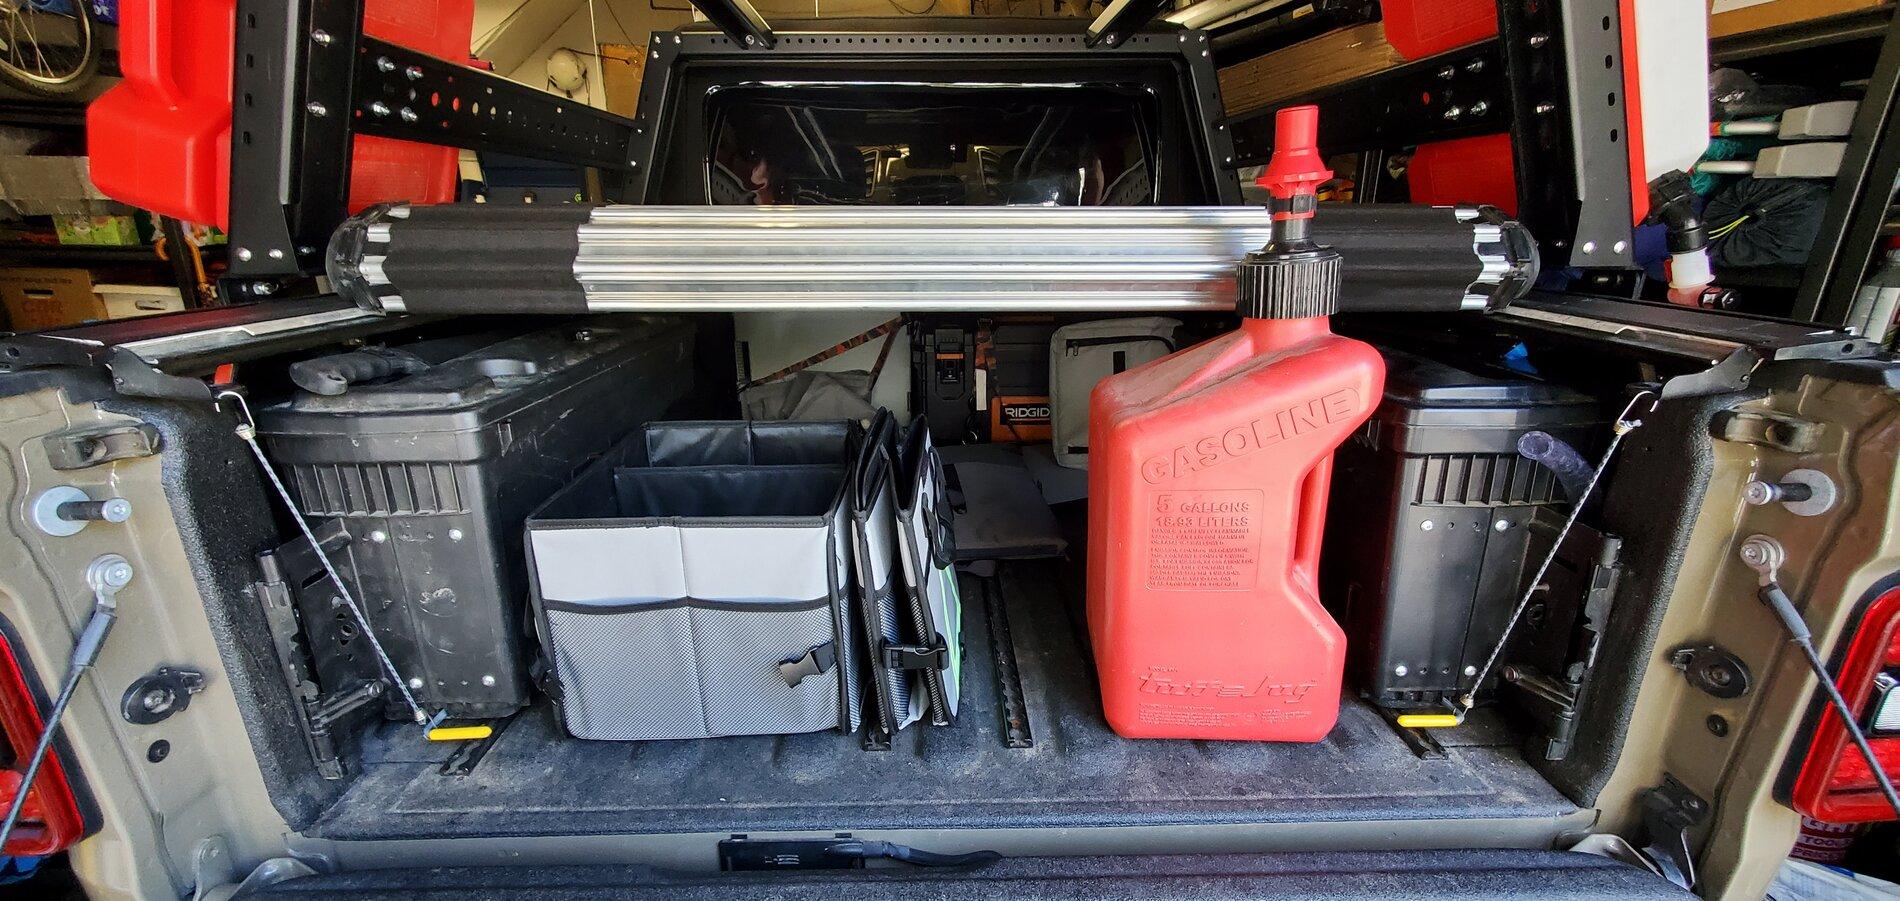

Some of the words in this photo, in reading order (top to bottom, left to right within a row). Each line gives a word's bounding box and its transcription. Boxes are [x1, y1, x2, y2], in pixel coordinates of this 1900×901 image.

[1004, 407, 1050, 418] RIDGID
[1140, 387, 1354, 484] GASOLINE
[1156, 494, 1173, 514] 5
[1180, 502, 1250, 514] GALLONS
[1198, 516, 1249, 528] LITERS
